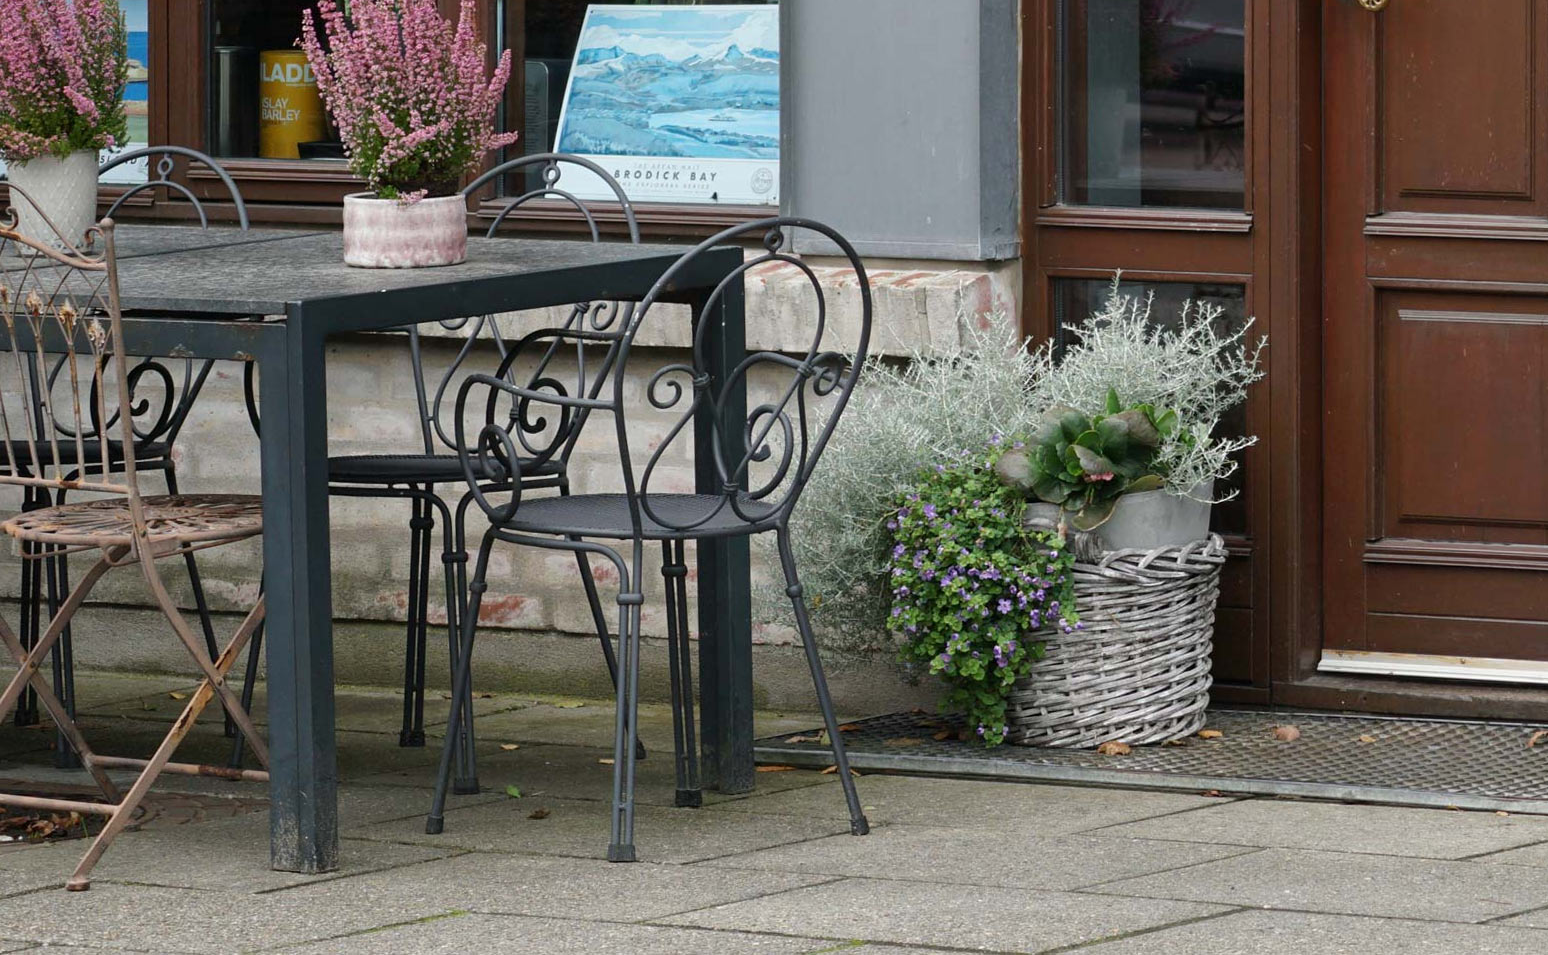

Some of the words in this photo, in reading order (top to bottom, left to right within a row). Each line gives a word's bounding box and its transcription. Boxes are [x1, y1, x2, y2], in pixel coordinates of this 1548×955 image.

[262, 109, 300, 121] BARLEY
[614, 169, 680, 181] BRODICK
[690, 172, 717, 181] BAY
